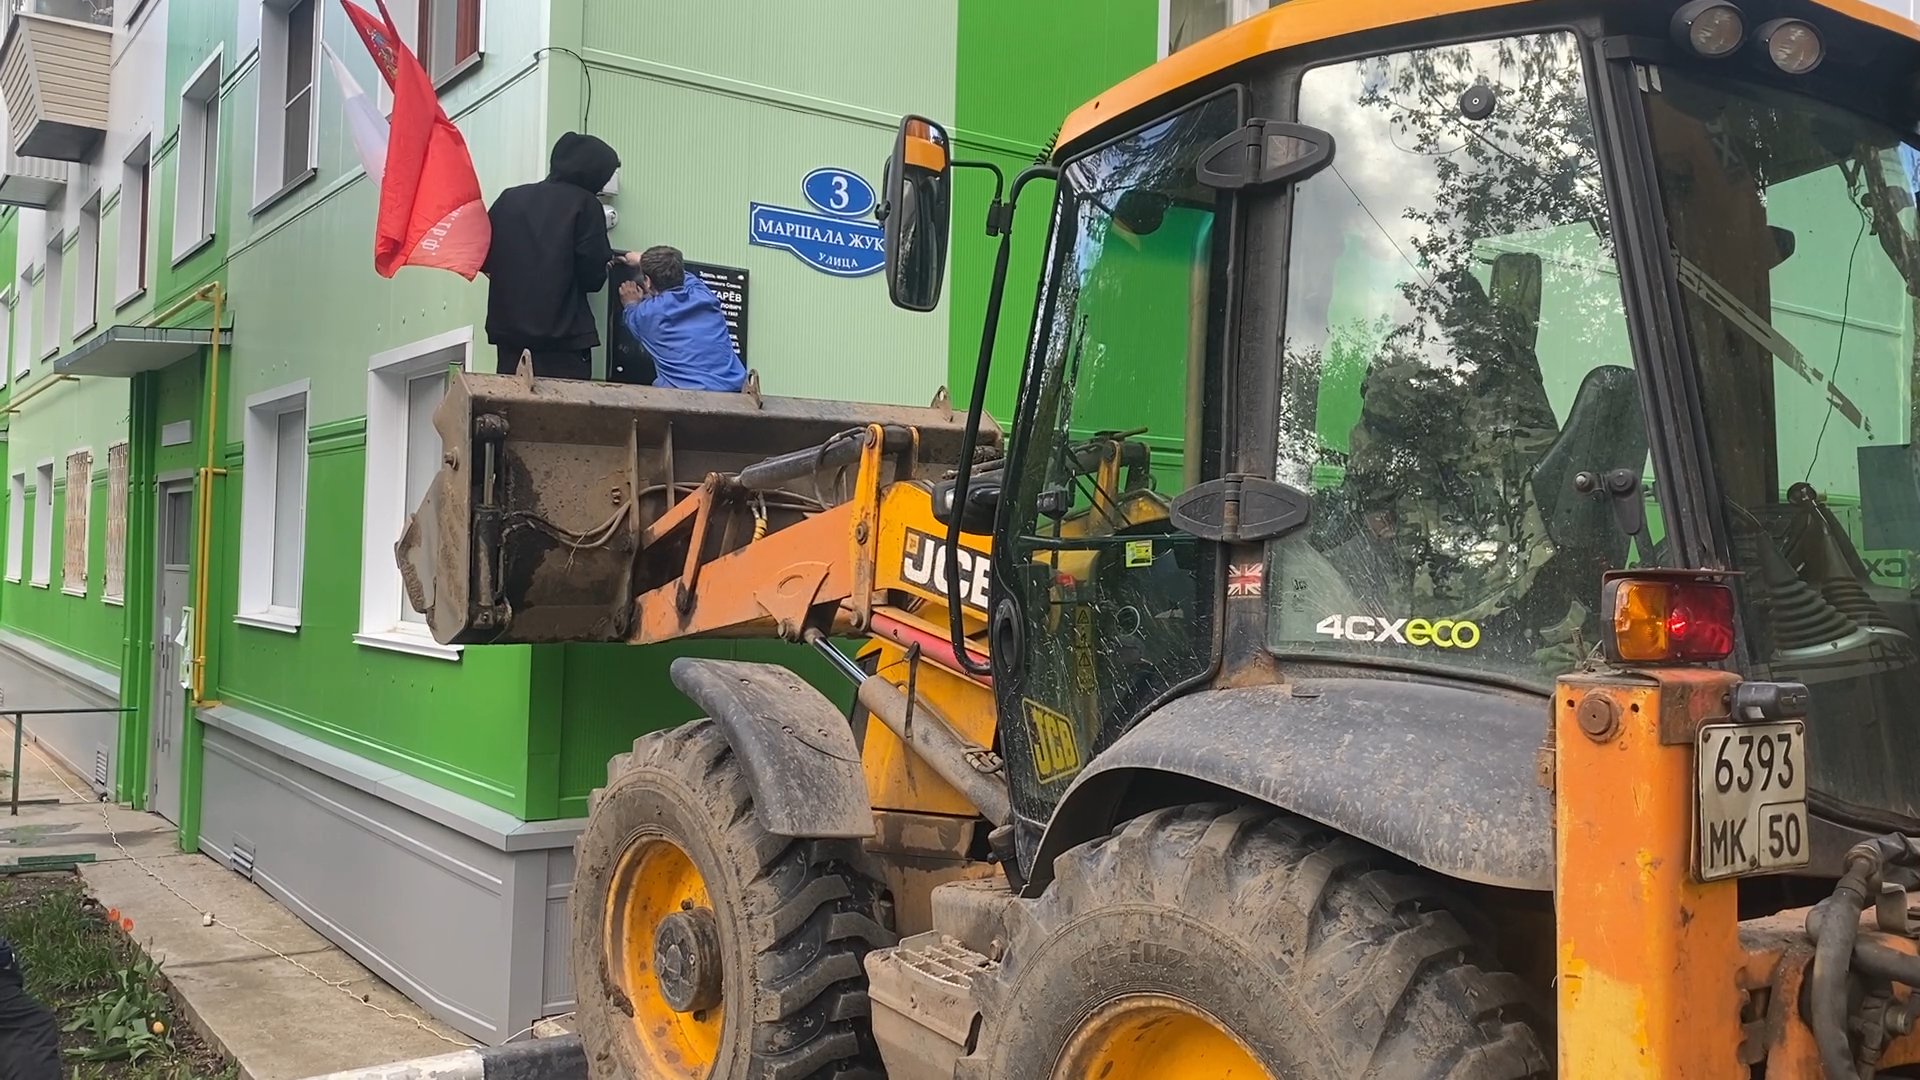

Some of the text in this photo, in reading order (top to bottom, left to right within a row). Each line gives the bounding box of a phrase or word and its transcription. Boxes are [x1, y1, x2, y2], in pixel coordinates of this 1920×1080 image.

[830, 176, 849, 209] 3
[758, 218, 844, 245] МАРШАЛА
[818, 252, 858, 268] УЛИЦА
[1032, 706, 1077, 775] JCB
[1715, 733, 1794, 794] 6393
[1709, 812, 1801, 869] МК 50
